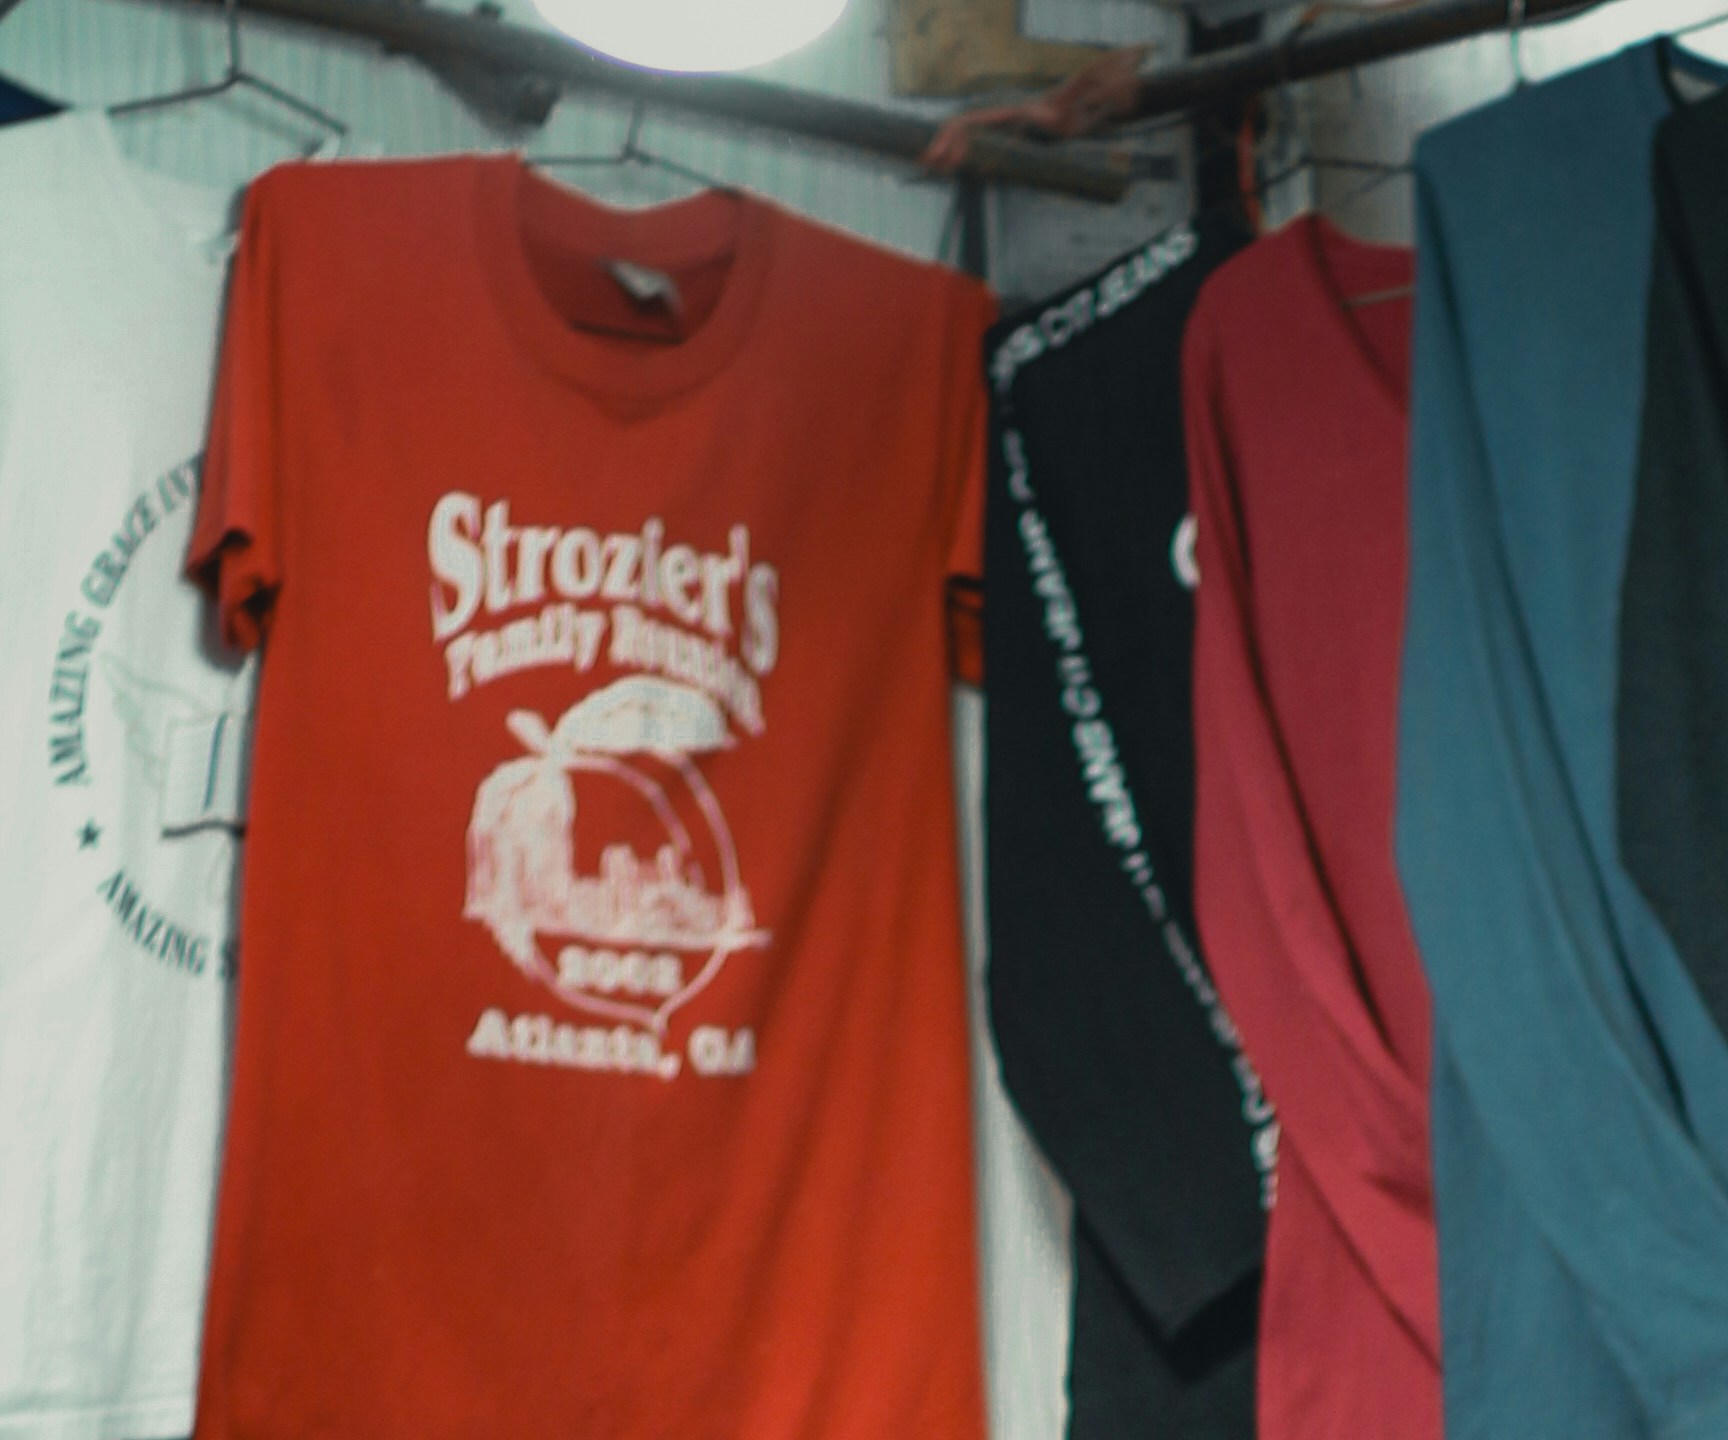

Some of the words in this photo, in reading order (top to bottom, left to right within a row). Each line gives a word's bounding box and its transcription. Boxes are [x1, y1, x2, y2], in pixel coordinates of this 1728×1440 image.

[48, 608, 102, 787] AMAZING
[79, 491, 160, 608] GRACE
[427, 490, 779, 677] Strozier's
